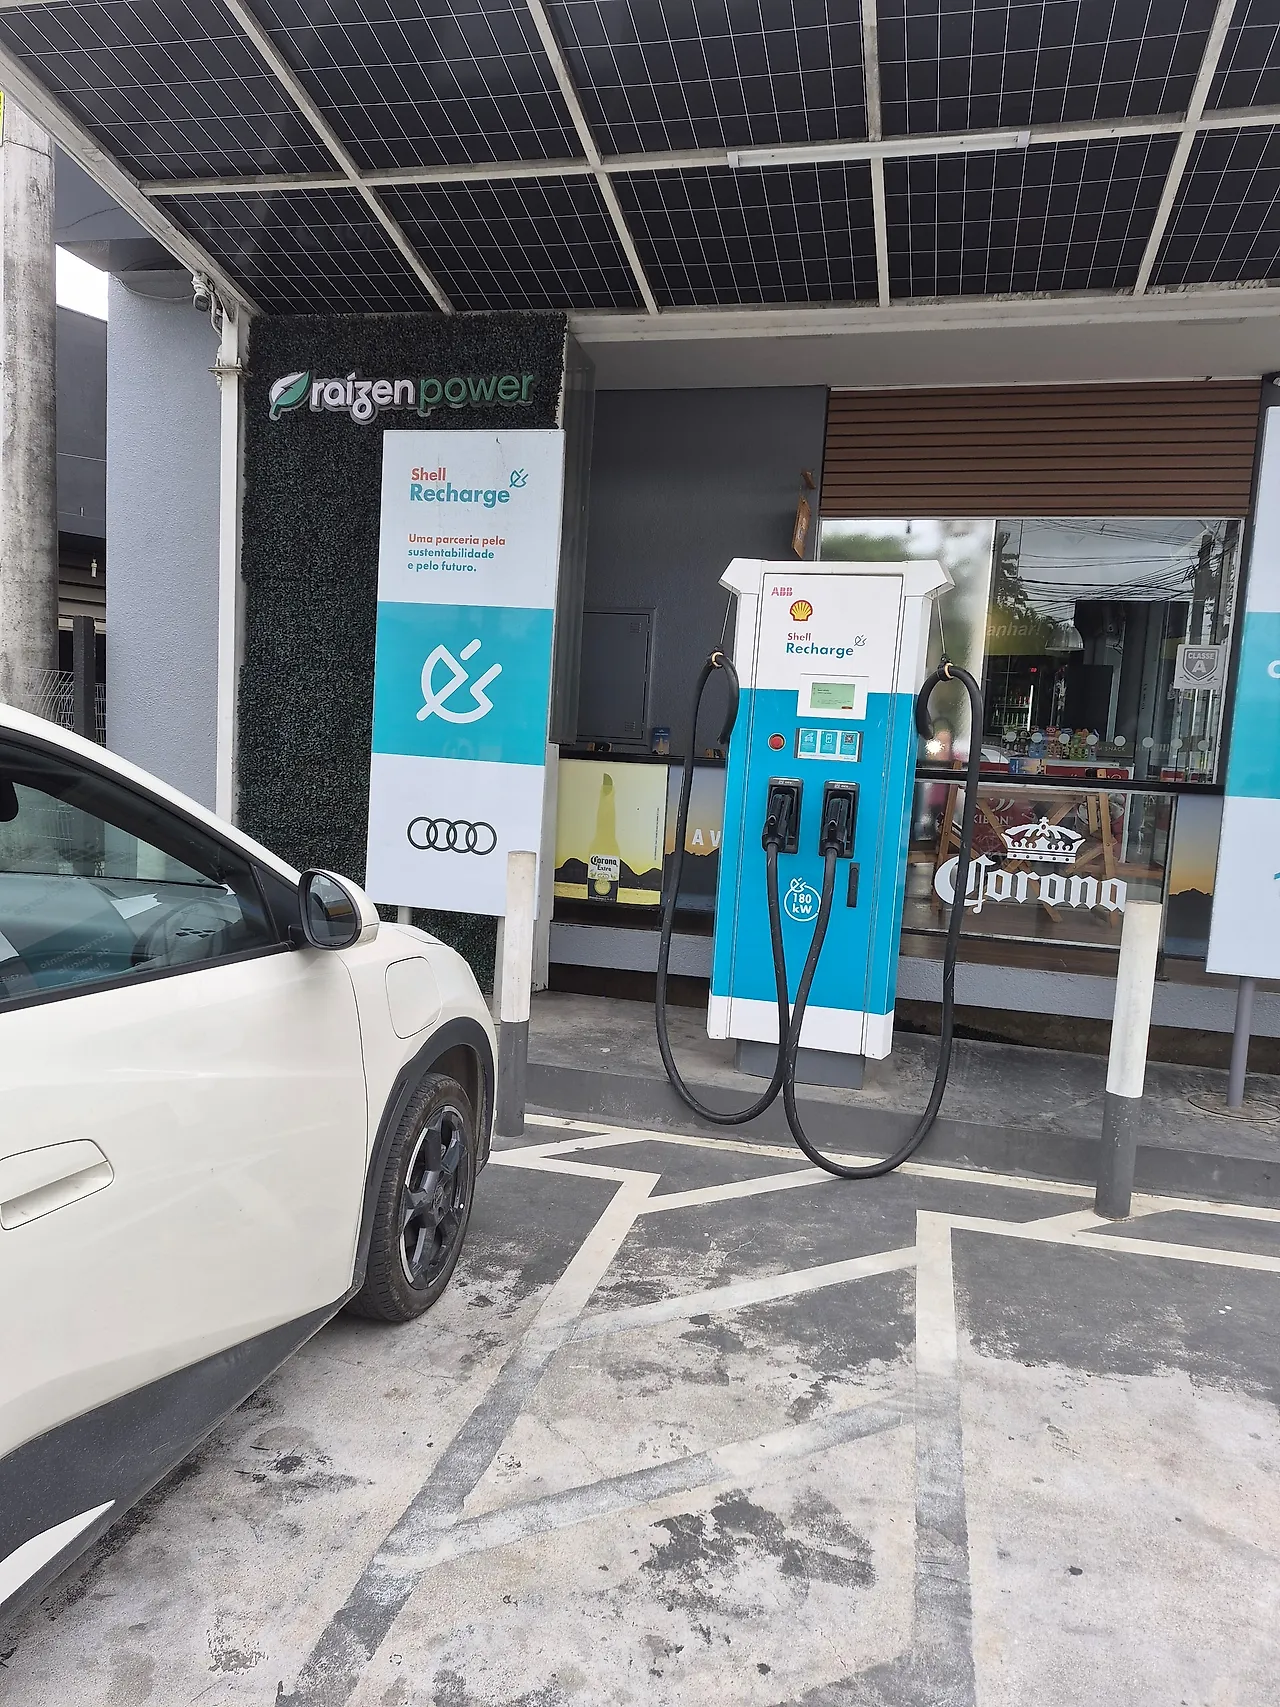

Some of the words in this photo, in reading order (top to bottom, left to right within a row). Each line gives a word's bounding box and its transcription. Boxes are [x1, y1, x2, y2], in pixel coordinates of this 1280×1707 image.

[419, 372, 534, 411] power
[411, 467, 447, 481] Shell
[409, 482, 510, 508] Recharge
[408, 533, 433, 545] Uma
[435, 534, 480, 547] parceria
[481, 535, 506, 547] pela
[407, 546, 495, 559] sustentabilidade
[407, 562, 414, 571] e
[415, 560, 439, 573] pelo
[441, 560, 477, 572] futuro.
[771, 586, 793, 596] ABB
[787, 632, 811, 641] Shell
[786, 642, 854, 659] Recharge
[1188, 652, 1215, 660] CLASSE
[1191, 660, 1207, 673] A
[590, 855, 619, 867] Corona
[934, 853, 1128, 914] Corona
[792, 892, 812, 904] 180
[792, 902, 813, 914] kW
